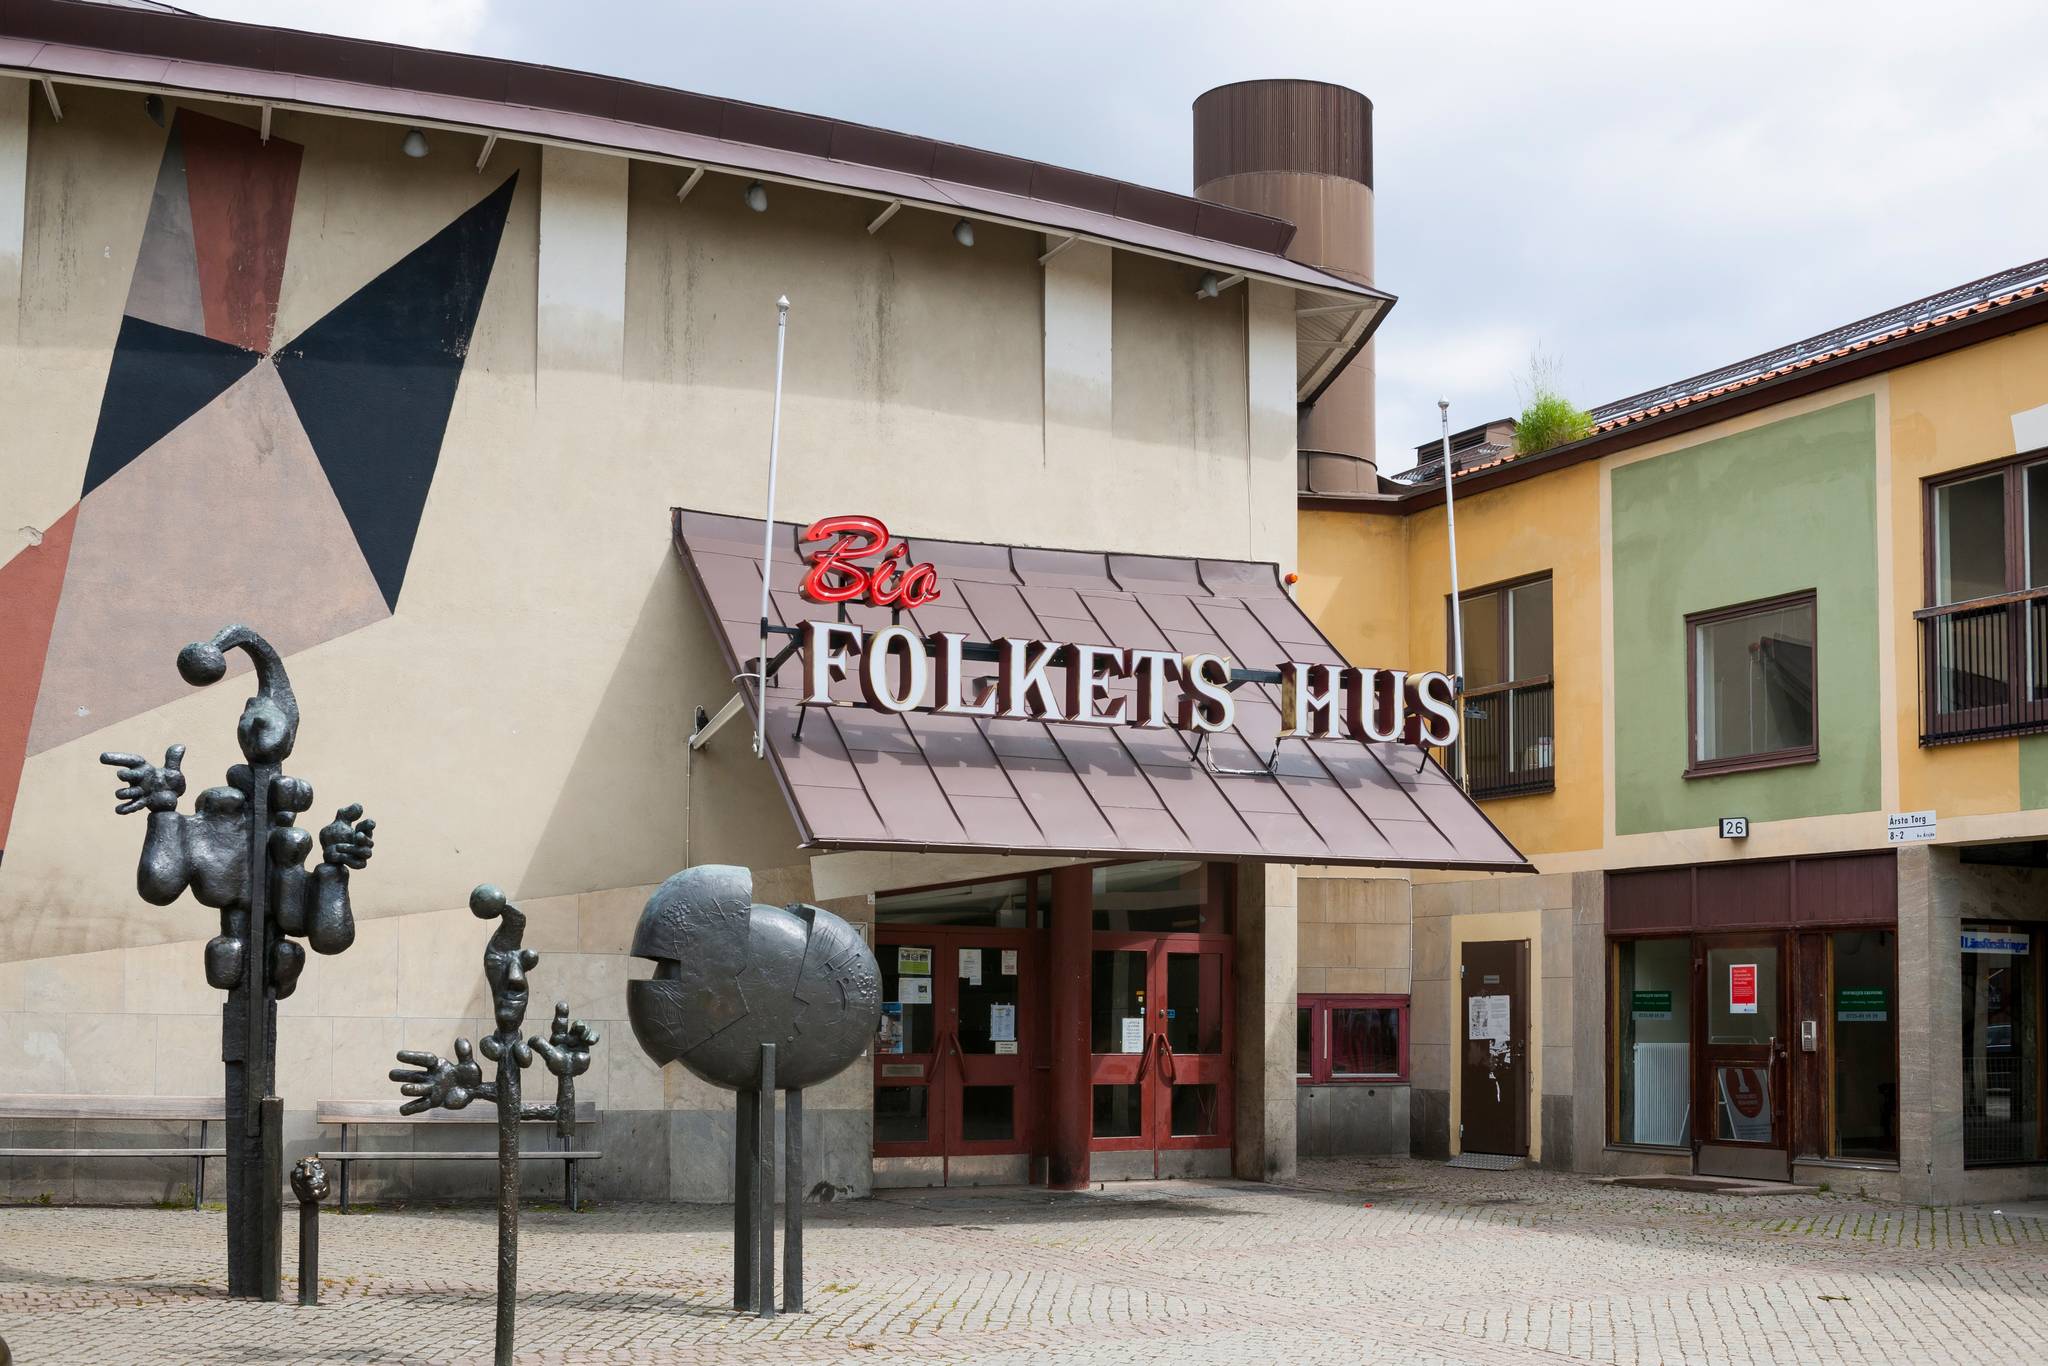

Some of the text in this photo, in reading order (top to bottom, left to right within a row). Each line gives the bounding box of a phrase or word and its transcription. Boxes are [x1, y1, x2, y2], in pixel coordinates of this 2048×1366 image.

[803, 514, 941, 609] Bio
[800, 619, 1460, 747] FOLKETS HUS
[1890, 815, 1926, 825] Årsta Torg
[1726, 821, 1744, 835] 26
[1890, 831, 1904, 840] 8-2
